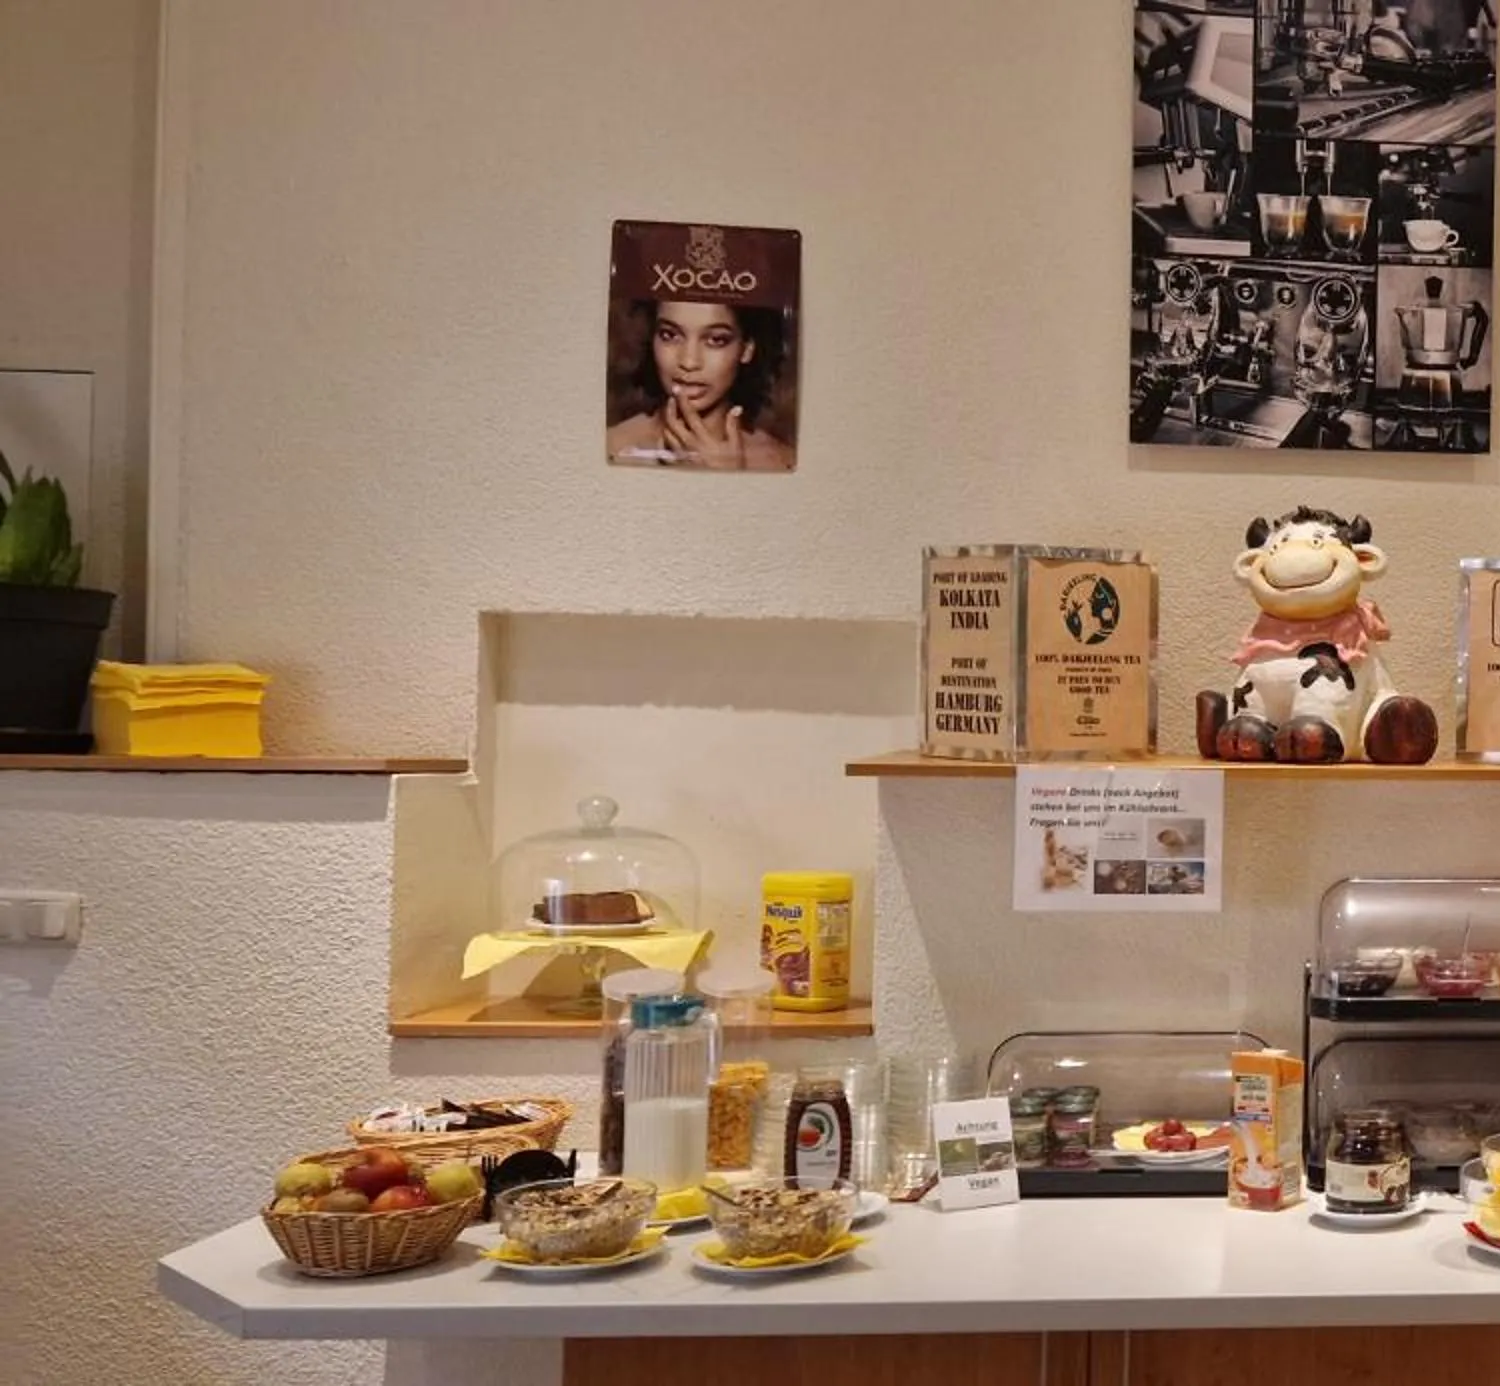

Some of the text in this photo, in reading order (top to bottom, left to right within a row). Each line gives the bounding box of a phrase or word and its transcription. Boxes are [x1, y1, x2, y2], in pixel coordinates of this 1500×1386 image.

[651, 264, 757, 292] XOCAO
[933, 571, 955, 585] PORT
[957, 571, 967, 584] OF
[939, 588, 1000, 608] KOLKATA
[951, 611, 989, 630] INDIA
[952, 656, 973, 669] PORT
[1123, 655, 1141, 665] TEA
[941, 674, 997, 689] DESTINATION
[936, 692, 1003, 713] HAMBURG
[936, 714, 1000, 735] GERMANY
[765, 903, 803, 921] Nesquik
